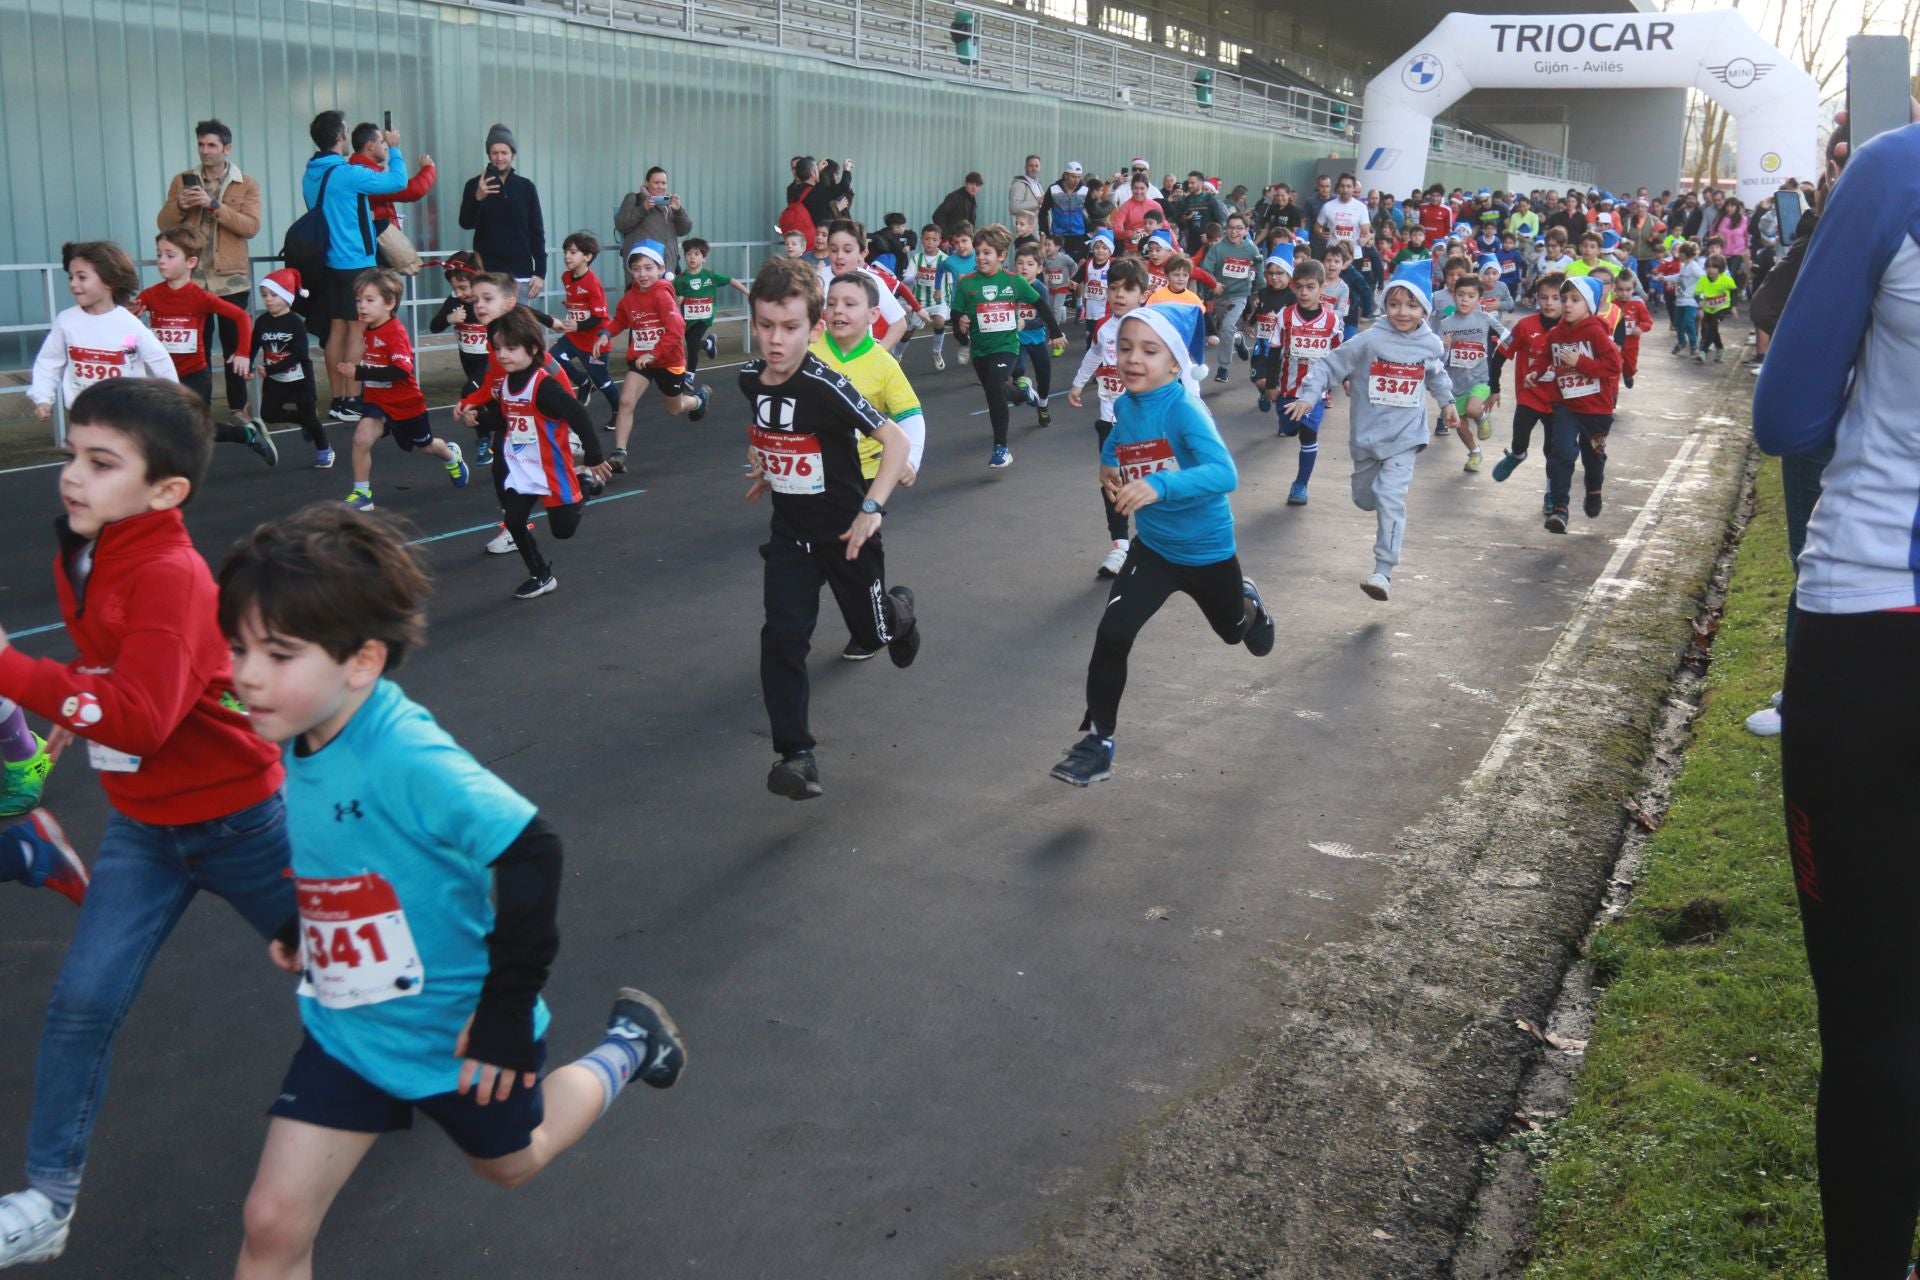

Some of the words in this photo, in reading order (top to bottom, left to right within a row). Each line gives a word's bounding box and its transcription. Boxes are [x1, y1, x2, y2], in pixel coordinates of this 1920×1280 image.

[1490, 22, 1675, 53] TRIOCAR
[1534, 61, 1569, 75] Gijón
[1582, 60, 1624, 73] Avilés
[1728, 69, 1753, 78] MINI
[1225, 264, 1246, 273] 4226
[688, 304, 711, 314] 3236
[1019, 310, 1033, 319] 64
[983, 312, 1010, 324] 3351
[156, 329, 191, 343] 3327
[1295, 337, 1328, 349] 3340
[74, 362, 122, 380] 3390
[1376, 377, 1418, 395] 3347
[757, 450, 812, 477] 3376
